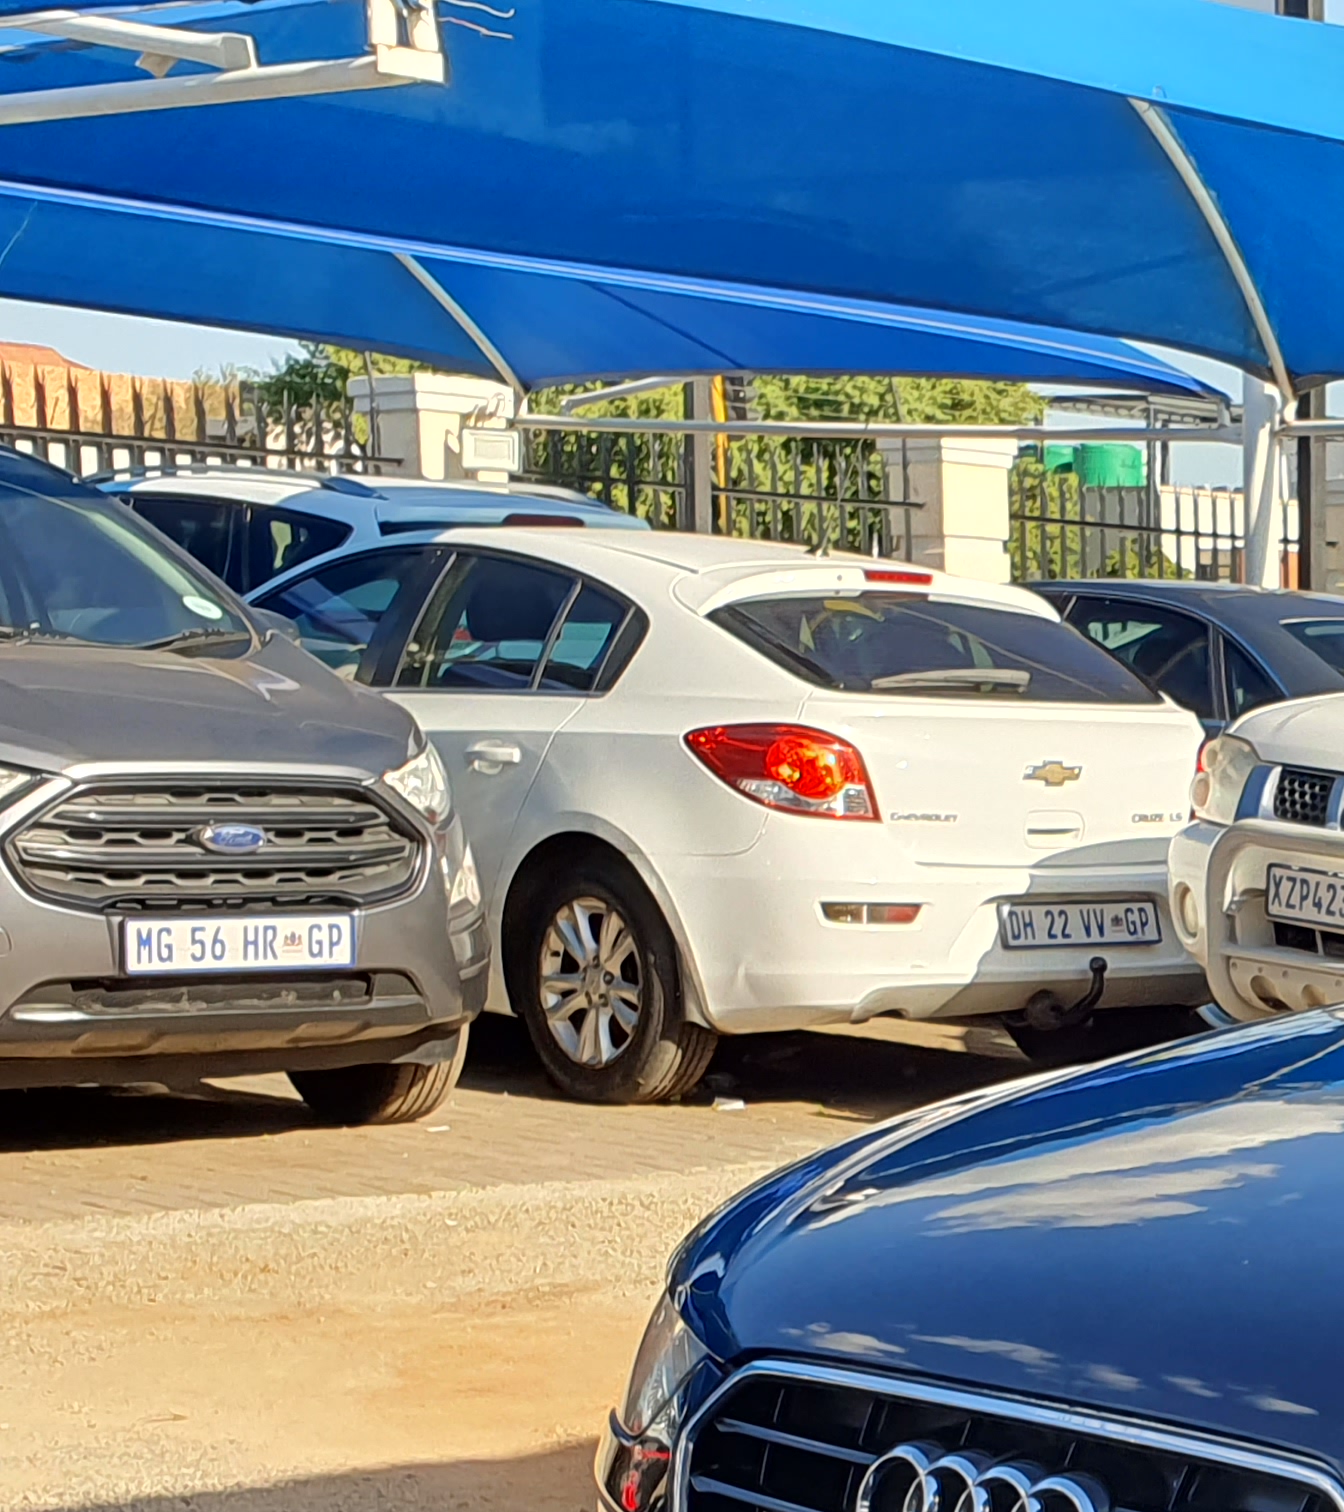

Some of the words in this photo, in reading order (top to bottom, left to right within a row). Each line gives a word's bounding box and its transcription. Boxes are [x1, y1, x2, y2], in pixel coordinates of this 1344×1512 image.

[1008, 910, 1036, 941] DH
[1044, 909, 1072, 940] 22
[1080, 908, 1105, 938] VV
[1123, 907, 1149, 937] GP
[136, 927, 173, 964] MG
[190, 926, 227, 962] 56
[242, 924, 279, 961] HR
[307, 923, 343, 959] GP
